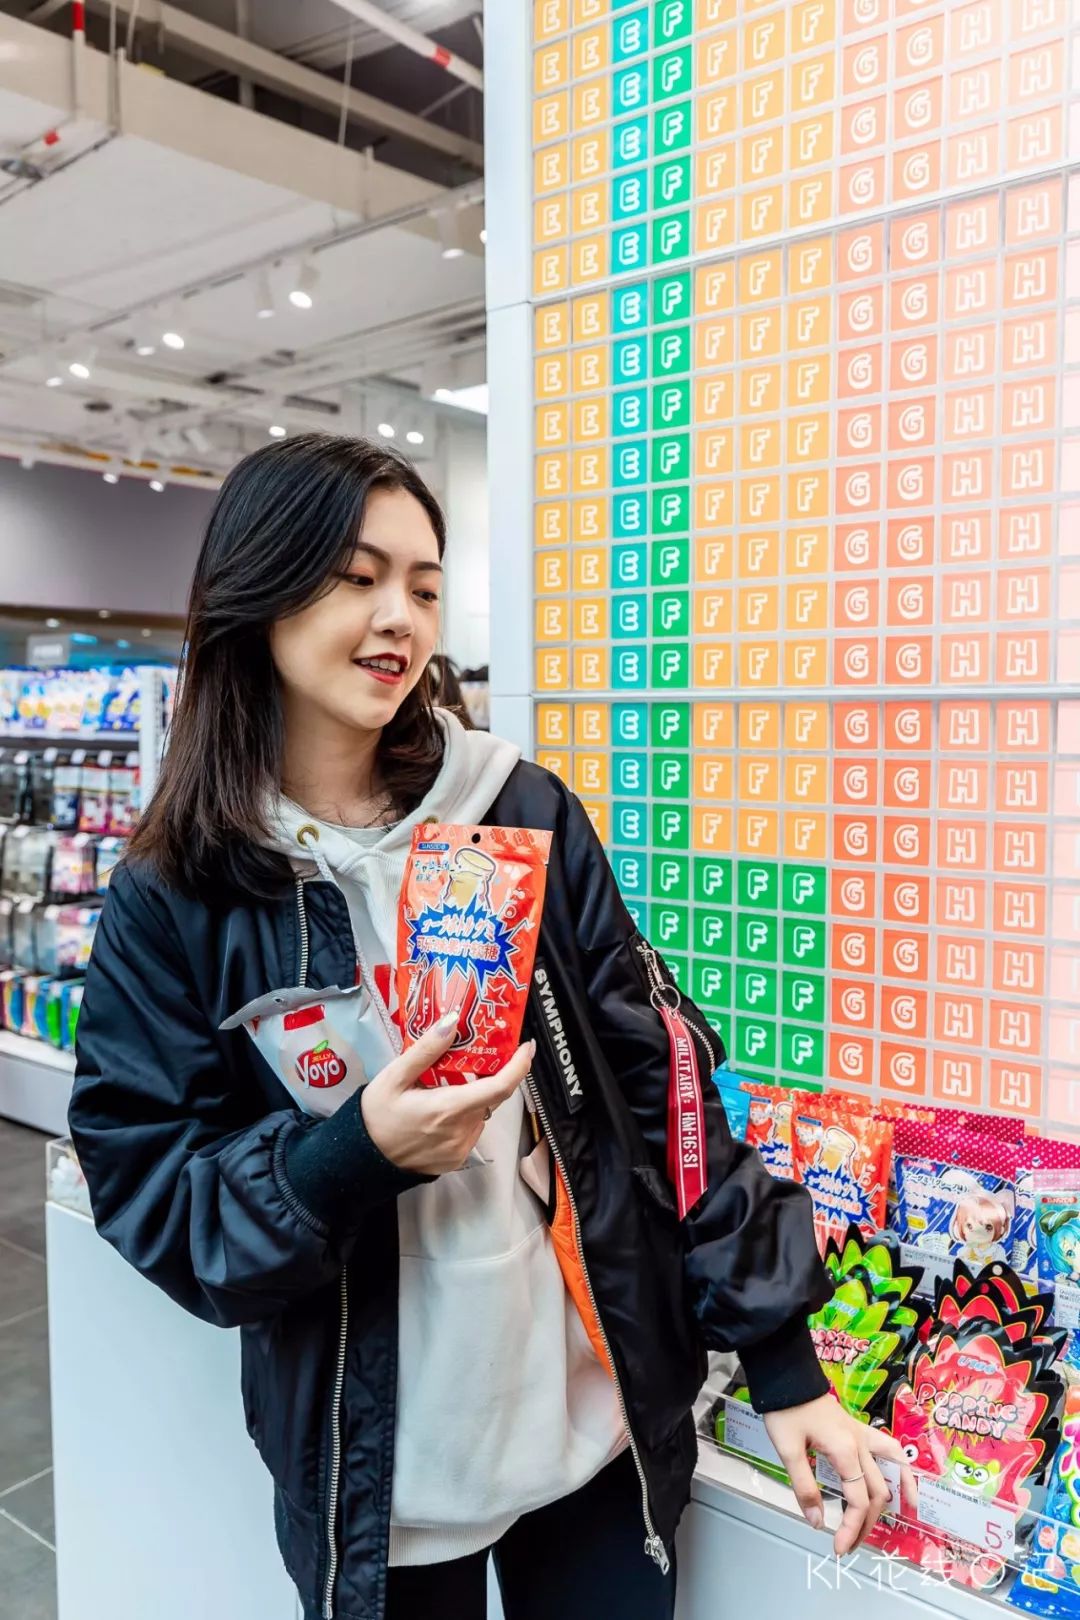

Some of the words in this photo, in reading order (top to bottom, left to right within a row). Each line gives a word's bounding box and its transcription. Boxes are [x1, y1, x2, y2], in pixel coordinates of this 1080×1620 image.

[543, 153, 561, 185] E
[580, 140, 600, 174] E
[619, 126, 642, 161] E
[661, 110, 685, 147] F
[706, 96, 728, 133] F
[752, 81, 774, 118] F
[800, 63, 824, 101] F
[852, 45, 879, 84] G
[906, 27, 933, 67] G
[959, 4, 993, 52] H
[543, 255, 560, 287] E
[580, 244, 599, 276] E
[618, 231, 641, 266] E
[659, 219, 683, 256] F
[705, 208, 727, 243] F
[751, 195, 774, 231] F
[799, 182, 823, 218] F
[848, 167, 875, 205] G
[903, 152, 930, 190] G
[955, 135, 989, 181] H
[1017, 117, 1052, 162] H
[544, 312, 561, 343] E
[581, 302, 600, 335] E
[619, 290, 643, 326] E
[661, 280, 684, 317] F
[704, 272, 727, 306] F
[749, 261, 772, 296] F
[799, 248, 823, 285] F
[847, 235, 873, 273] G
[901, 222, 929, 261] G
[955, 206, 989, 250] H
[1016, 191, 1050, 236] H
[544, 411, 562, 441] E
[580, 404, 600, 436] E
[619, 395, 641, 429] E
[660, 387, 684, 422] F
[703, 381, 725, 415] F
[749, 373, 772, 408] F
[796, 363, 820, 399] F
[847, 352, 872, 389] G
[900, 344, 928, 382] G
[953, 334, 986, 375] H
[1012, 321, 1046, 364] H
[544, 460, 561, 490] E
[580, 455, 599, 485] E
[619, 447, 641, 480] E
[659, 440, 682, 475] F
[705, 436, 726, 468] F
[749, 429, 772, 462] F
[795, 422, 819, 456] F
[847, 413, 872, 449] G
[898, 404, 925, 441] G
[953, 394, 985, 435] H
[1011, 385, 1046, 427] H
[544, 558, 561, 587] E
[581, 554, 600, 584] E
[618, 549, 640, 583] E
[658, 545, 681, 579] F
[703, 543, 724, 575] F
[747, 539, 769, 572] F
[795, 534, 817, 568] F
[844, 528, 869, 565] G
[896, 524, 924, 561] G
[950, 519, 981, 558] H
[1008, 512, 1041, 552] H
[544, 606, 562, 635] E
[580, 605, 599, 635] E
[618, 600, 640, 633] E
[660, 597, 683, 631] F
[702, 596, 724, 628] F
[746, 593, 768, 625] F
[795, 591, 818, 623] F
[844, 587, 870, 622] G
[897, 584, 924, 620] G
[950, 580, 982, 617] H
[1007, 575, 1039, 614] H
[544, 656, 561, 684] E
[582, 653, 600, 683] E
[618, 650, 640, 683] E
[659, 648, 682, 682] F
[703, 649, 724, 680] F
[749, 648, 769, 680] F
[794, 646, 817, 680] F
[844, 644, 869, 679] G
[895, 644, 922, 679] G
[950, 640, 981, 678] H
[1005, 638, 1039, 677] H
[546, 711, 563, 740] E
[583, 710, 601, 740] E
[620, 708, 640, 741] E
[658, 707, 682, 741] F
[703, 710, 723, 741] F
[749, 710, 770, 742] F
[795, 709, 817, 742] F
[844, 710, 870, 744] G
[894, 709, 921, 744] G
[949, 708, 980, 745] H
[1007, 708, 1040, 746] H
[583, 759, 601, 789] E
[620, 757, 641, 790] E
[660, 758, 682, 791] F
[703, 762, 723, 792] F
[748, 763, 769, 794] F
[795, 764, 817, 797] F
[843, 765, 868, 800] G
[893, 767, 920, 802] G
[947, 768, 979, 804] H
[1004, 770, 1038, 806] H
[618, 856, 640, 890] E
[659, 860, 681, 893] F
[702, 864, 725, 896] F
[746, 867, 770, 901] F
[792, 871, 817, 906] F
[840, 877, 865, 912] G
[893, 882, 920, 917] G
[944, 885, 976, 923] H
[1003, 891, 1035, 929] H
[658, 910, 680, 941] F
[702, 914, 724, 948] F
[746, 920, 769, 953] F
[791, 924, 817, 959] F
[841, 932, 866, 966] G
[893, 938, 920, 973] G
[945, 944, 976, 981] H
[1002, 950, 1035, 988] H
[534, 968, 583, 1097] SYMPHONY
[744, 1024, 768, 1057] F
[790, 1032, 815, 1066] F
[838, 1042, 864, 1076] G
[890, 1052, 916, 1087] G
[942, 1060, 973, 1097] H
[999, 1069, 1032, 1109] H
[675, 1037, 696, 1104] MILITARY:
[916, 1383, 1018, 1422] POPPING
[933, 1405, 1007, 1440] CANDY
